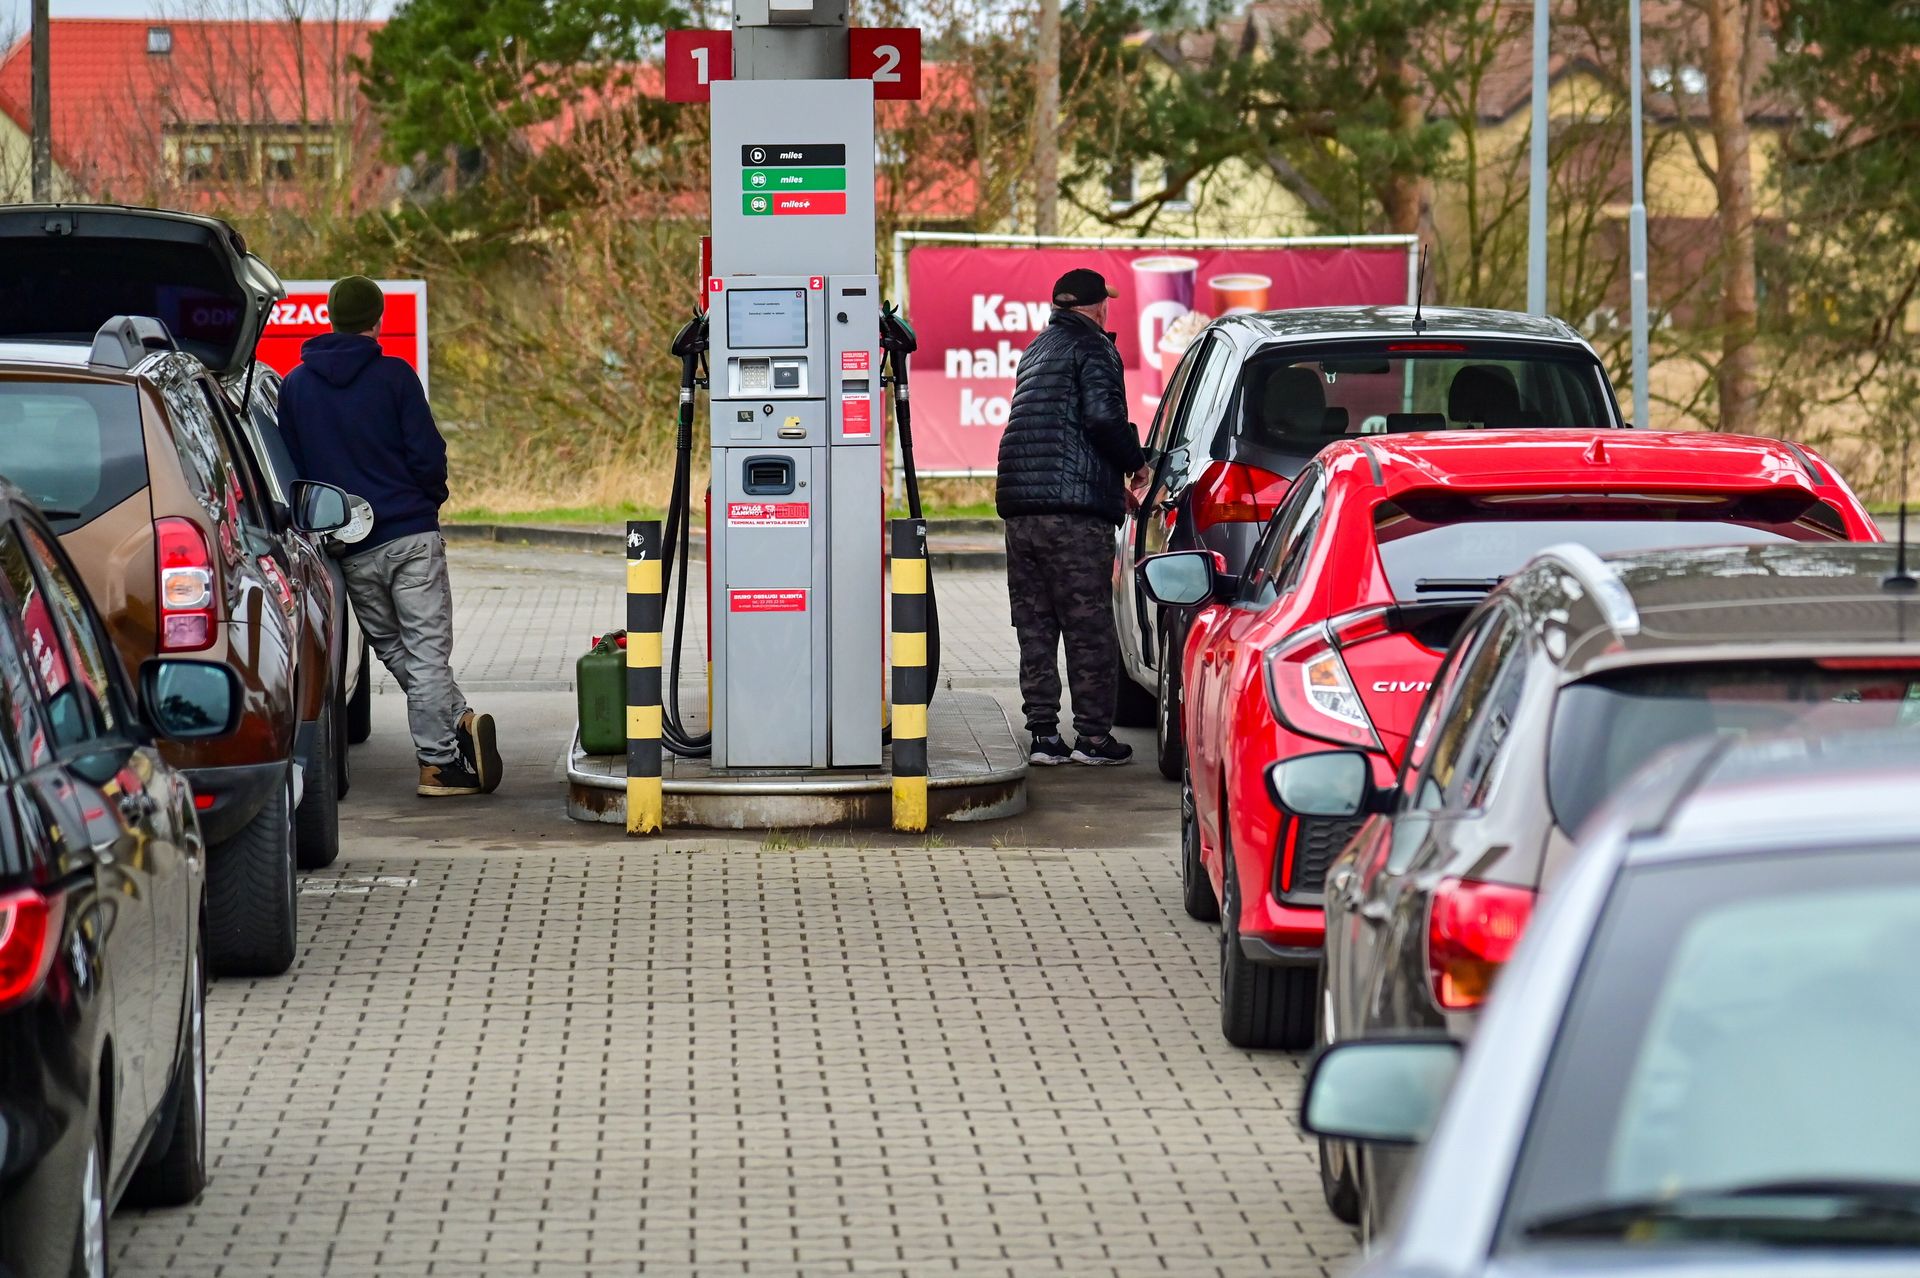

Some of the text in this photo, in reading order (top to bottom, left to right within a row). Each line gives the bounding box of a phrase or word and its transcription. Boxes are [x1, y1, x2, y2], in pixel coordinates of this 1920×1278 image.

[691, 47, 708, 85] 1
[872, 45, 901, 82] 2
[754, 151, 803, 160] D miles
[752, 175, 803, 184] 95 miles
[713, 280, 719, 290] 1
[812, 279, 820, 288] 2
[972, 293, 1052, 332] Kaw
[945, 339, 1023, 379] nab
[960, 387, 1015, 426] ko
[1373, 681, 1431, 692] CIVI
